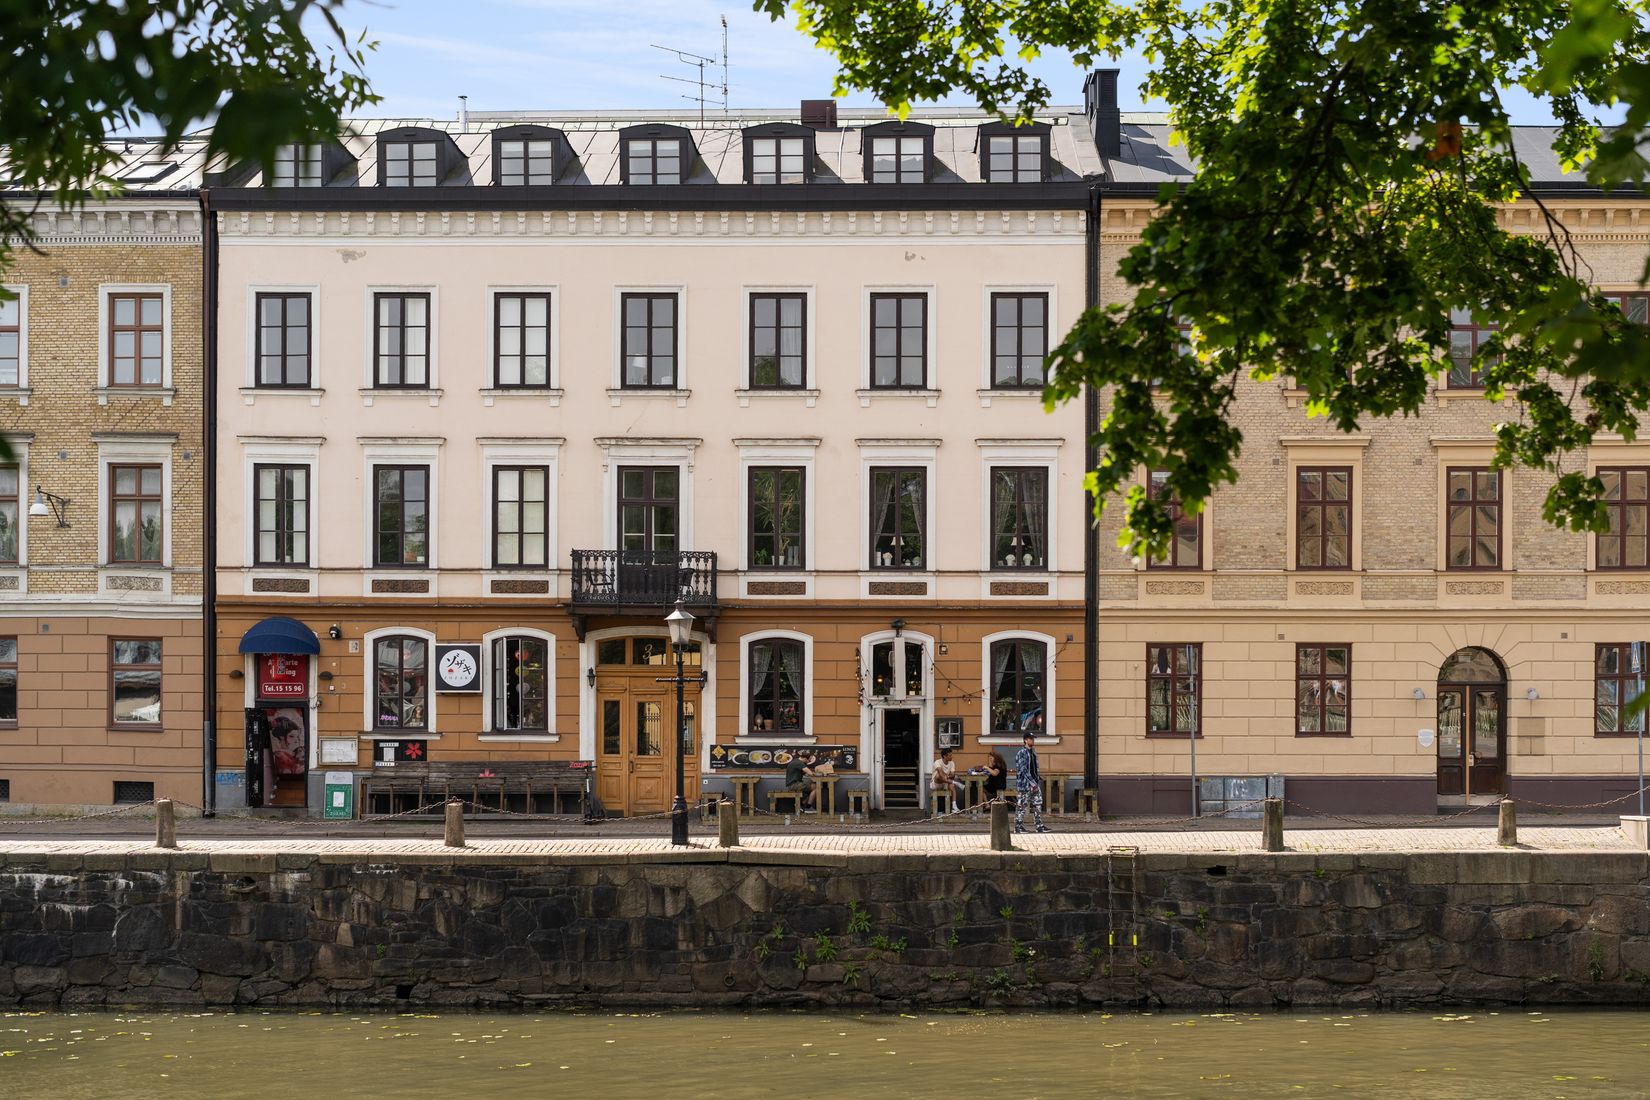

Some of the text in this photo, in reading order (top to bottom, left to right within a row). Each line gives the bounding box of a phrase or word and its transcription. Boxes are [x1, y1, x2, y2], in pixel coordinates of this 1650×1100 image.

[643, 644, 652, 659] 3
[447, 653, 472, 675] ゾザキ
